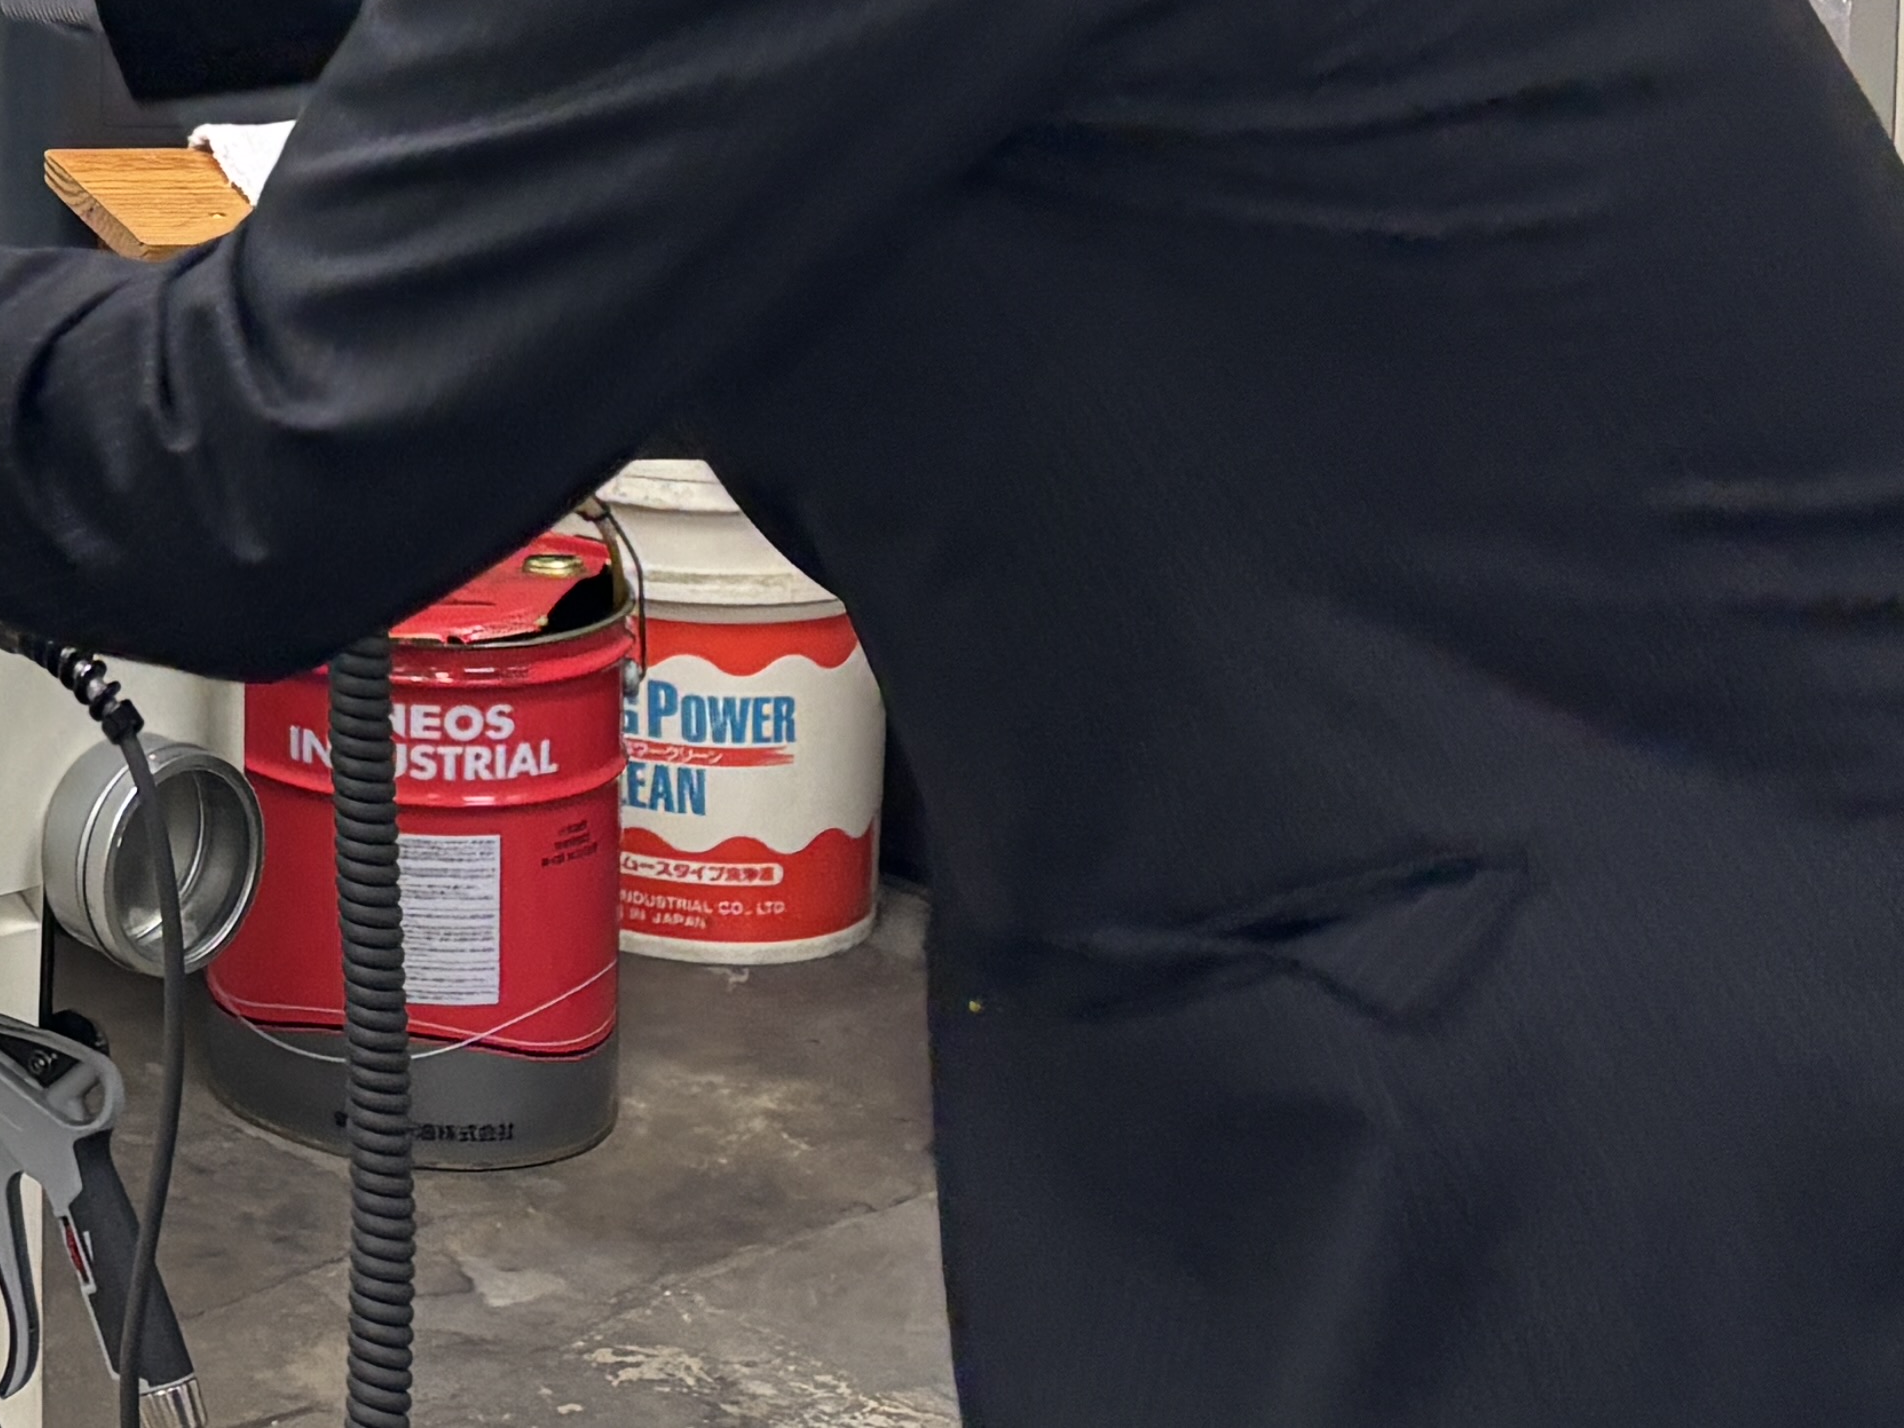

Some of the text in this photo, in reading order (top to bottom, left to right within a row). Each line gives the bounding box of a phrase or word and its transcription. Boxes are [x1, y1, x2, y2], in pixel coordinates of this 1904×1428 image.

[389, 702, 516, 742] NEOS
[647, 679, 797, 745] POWER
[622, 761, 707, 817] EAN
[652, 910, 708, 930] JAPAN
